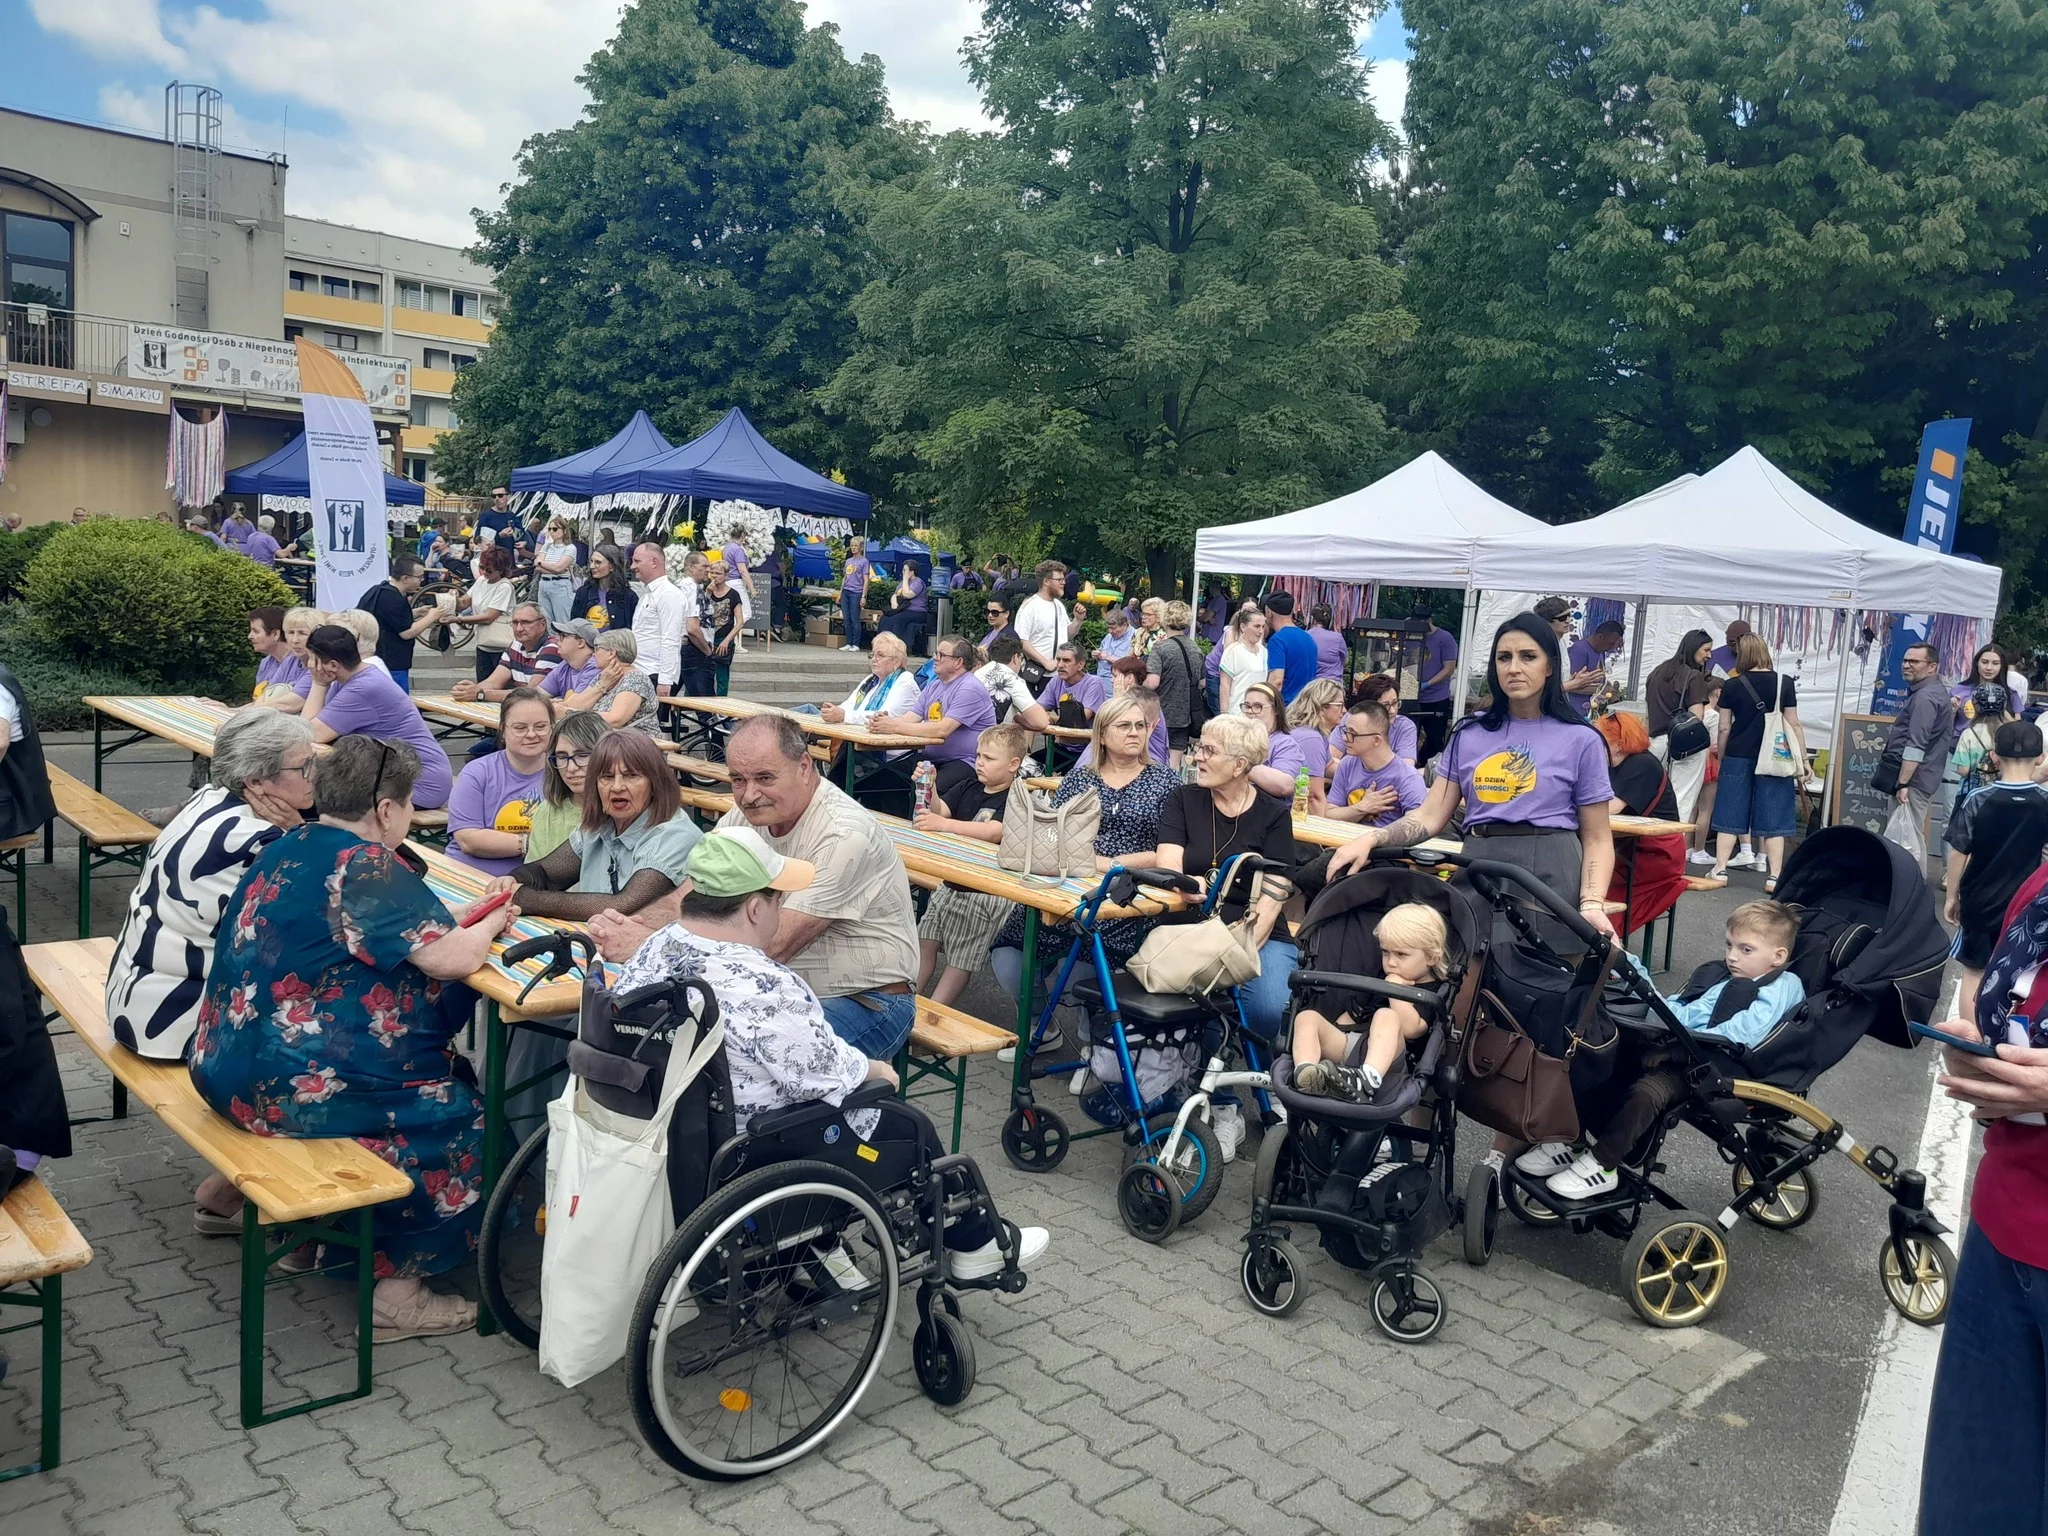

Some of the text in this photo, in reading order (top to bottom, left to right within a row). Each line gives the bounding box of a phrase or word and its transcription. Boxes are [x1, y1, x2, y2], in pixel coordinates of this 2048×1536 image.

[133, 325, 162, 337] Dzień
[164, 330, 210, 344] Godności
[212, 337, 236, 348] Osób
[263, 355, 274, 364] 23
[11, 373, 161, 401] STREFA SMAKU
[790, 512, 850, 531] SMAKU
